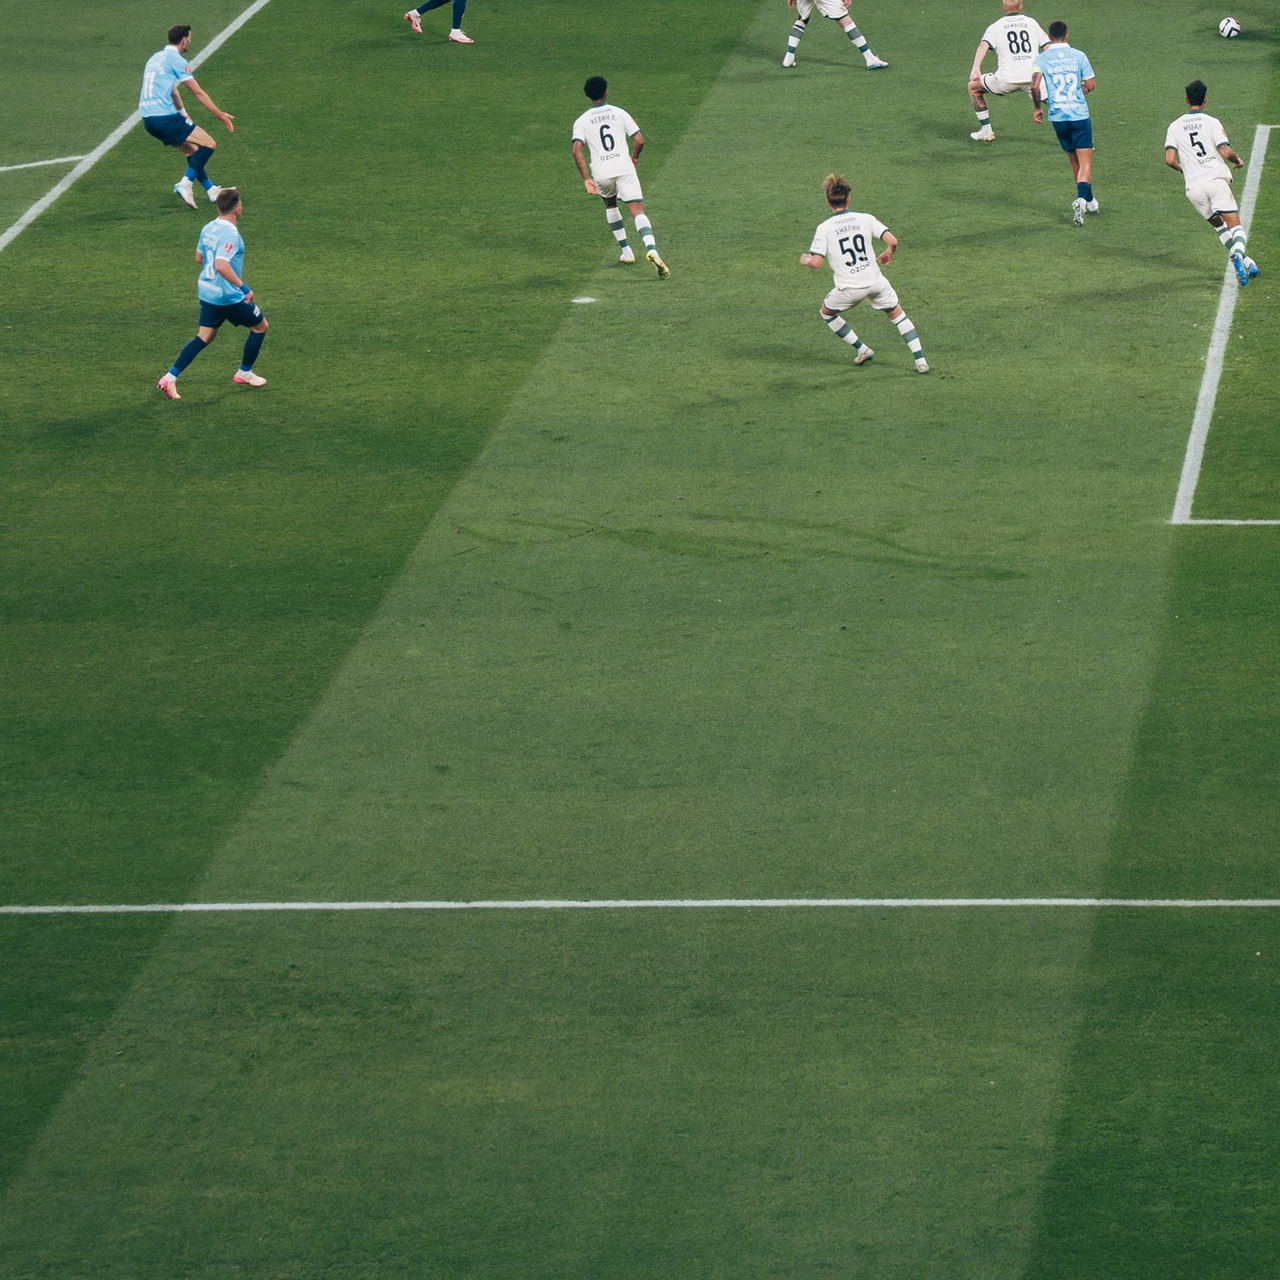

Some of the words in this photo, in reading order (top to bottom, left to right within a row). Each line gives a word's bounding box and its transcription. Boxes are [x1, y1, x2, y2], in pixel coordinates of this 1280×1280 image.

[1006, 30, 1032, 55] 88
[143, 71, 156, 99] 11
[1052, 73, 1078, 102] 22
[599, 124, 615, 152] 6
[1189, 131, 1207, 158] 5
[600, 153, 621, 161] OZON
[838, 233, 869, 267] 59
[205, 249, 217, 280] 8
[850, 262, 871, 274] OZON
